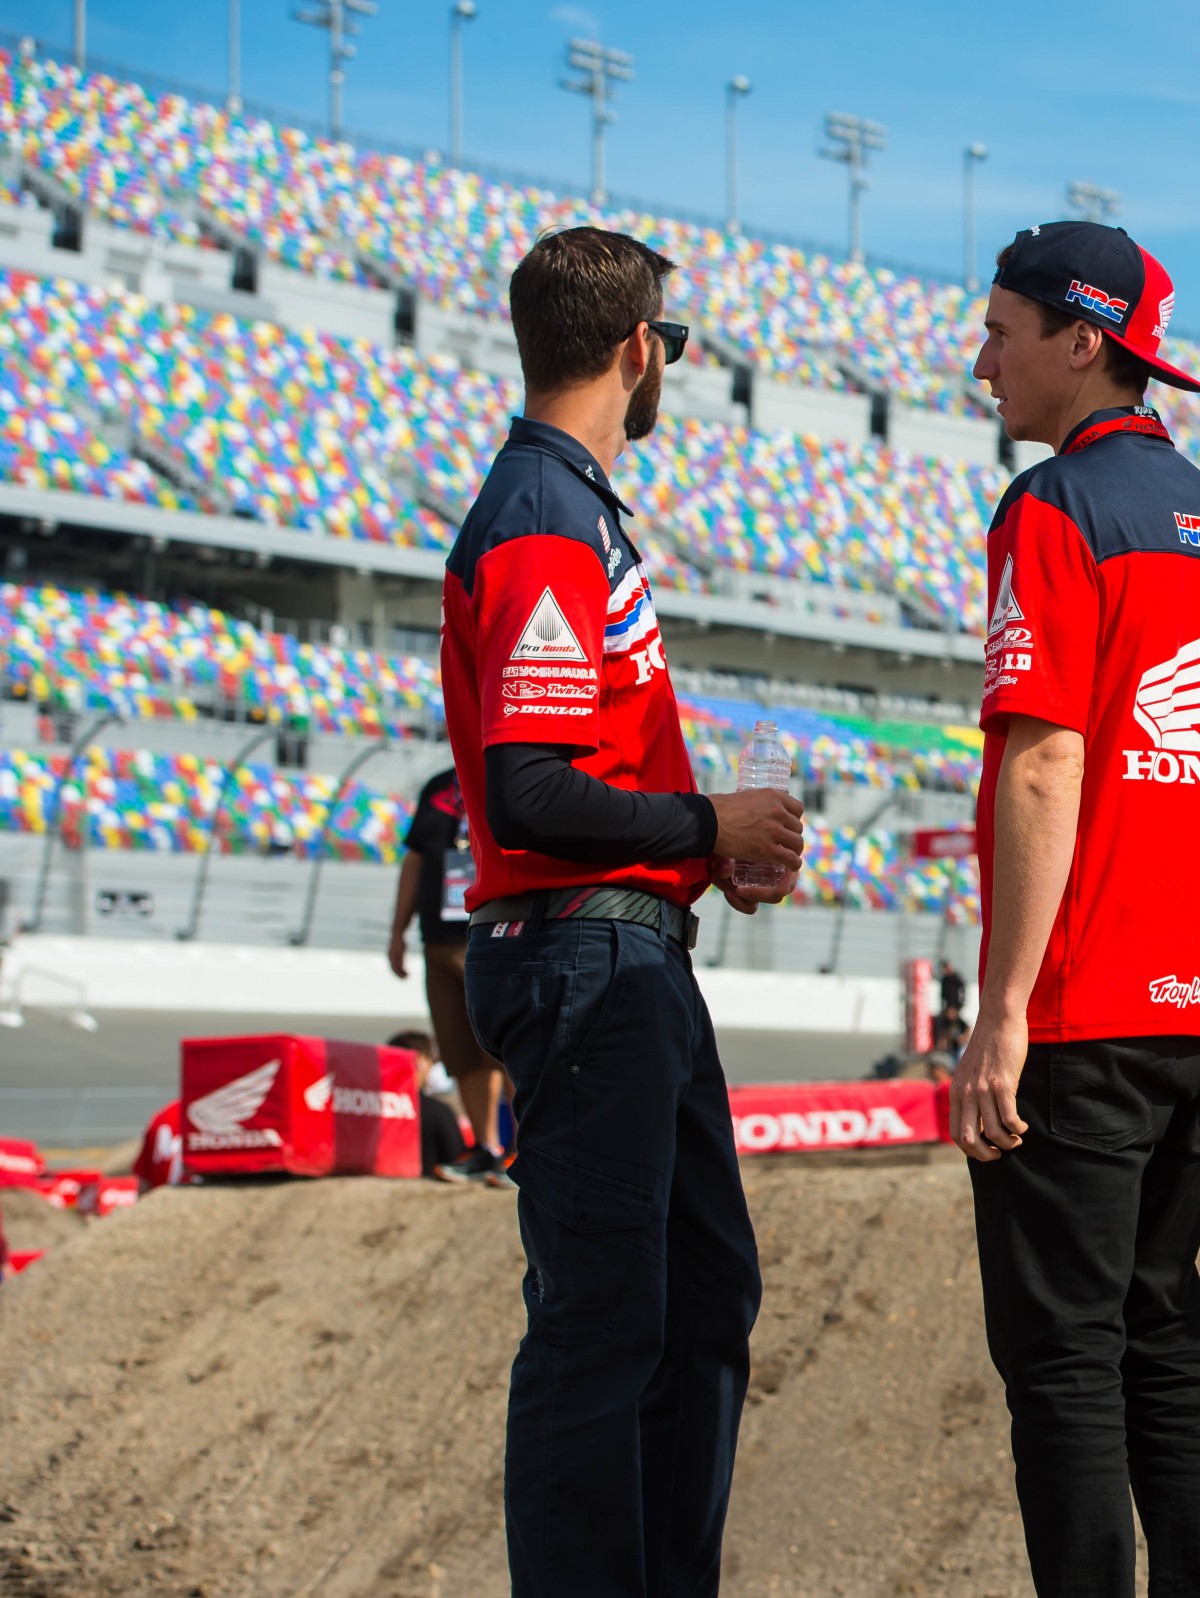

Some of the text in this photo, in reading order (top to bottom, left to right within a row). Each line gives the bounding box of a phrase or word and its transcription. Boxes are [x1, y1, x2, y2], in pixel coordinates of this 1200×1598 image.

[1065, 280, 1128, 323] HRC
[1134, 405, 1153, 415] RIDE
[520, 643, 576, 653] Pro Honda
[518, 666, 598, 680] YOSHIMURA
[548, 684, 580, 696] Twin
[518, 705, 593, 716] DUNLOP
[331, 1087, 417, 1119] HONDA
[733, 1107, 914, 1150] ONDA
